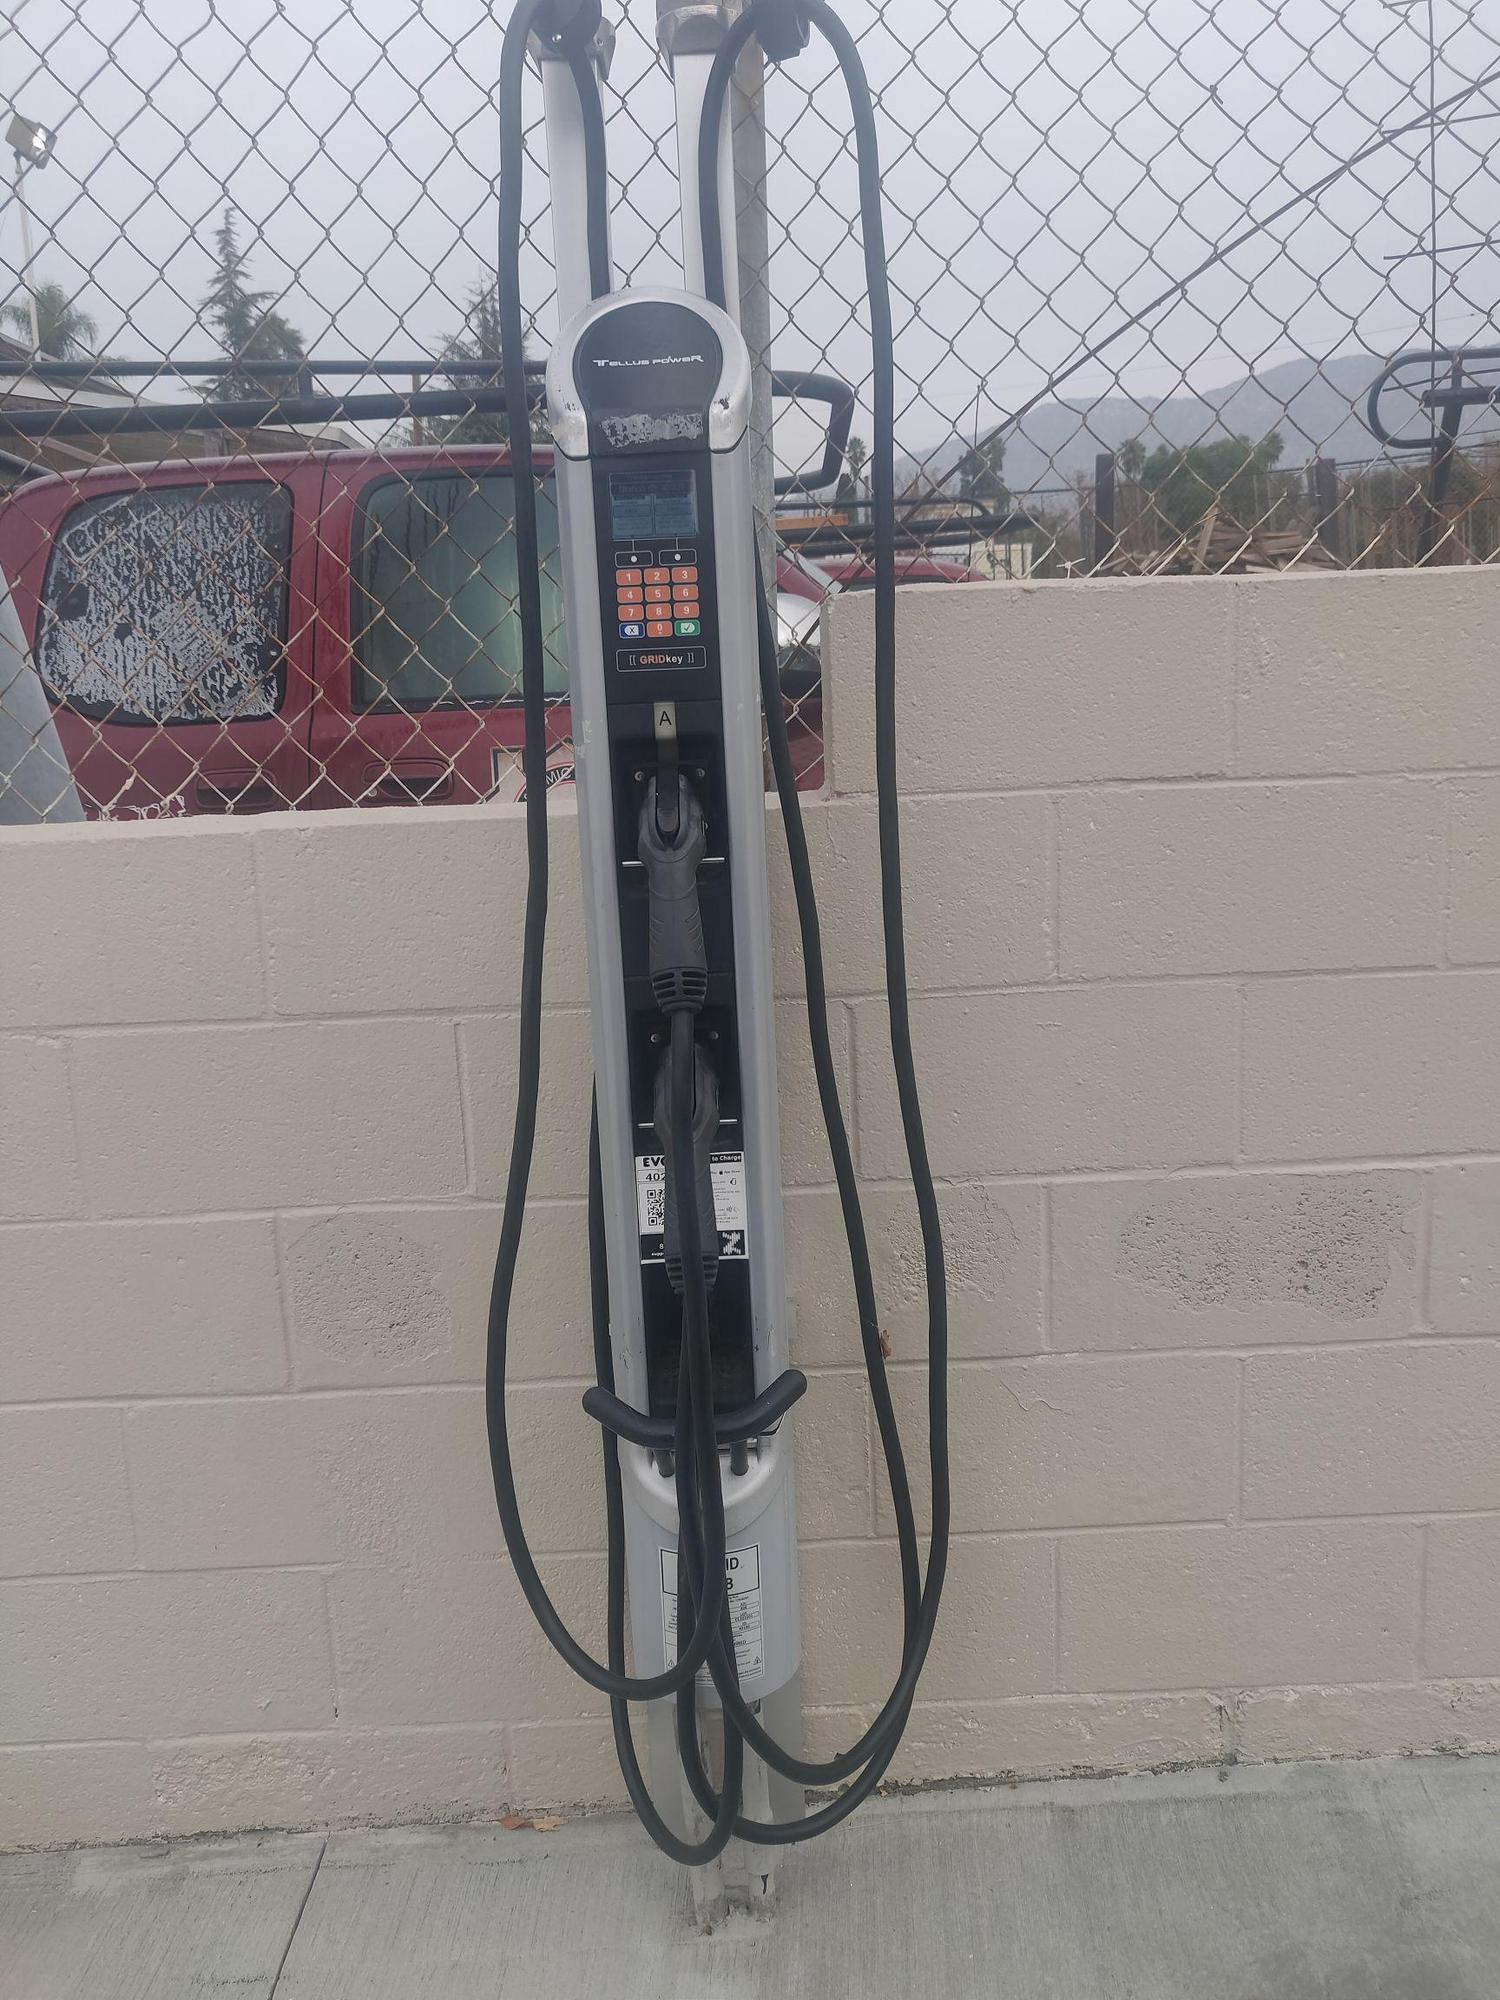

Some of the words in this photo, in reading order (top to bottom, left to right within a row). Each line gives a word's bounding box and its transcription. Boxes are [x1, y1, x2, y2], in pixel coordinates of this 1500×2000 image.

[626, 573, 632, 582] 1
[654, 572, 660, 581] 2
[682, 571, 688, 579] 3
[626, 591, 633, 600] 4
[655, 590, 661, 599] 5
[683, 588, 689, 597] 6
[628, 608, 634, 617] 7
[656, 607, 662, 616] 8
[683, 606, 690, 615] 9
[640, 653, 683, 665] GRIDkey
[659, 710, 672, 726] A
[719, 1154, 741, 1162] Charge
